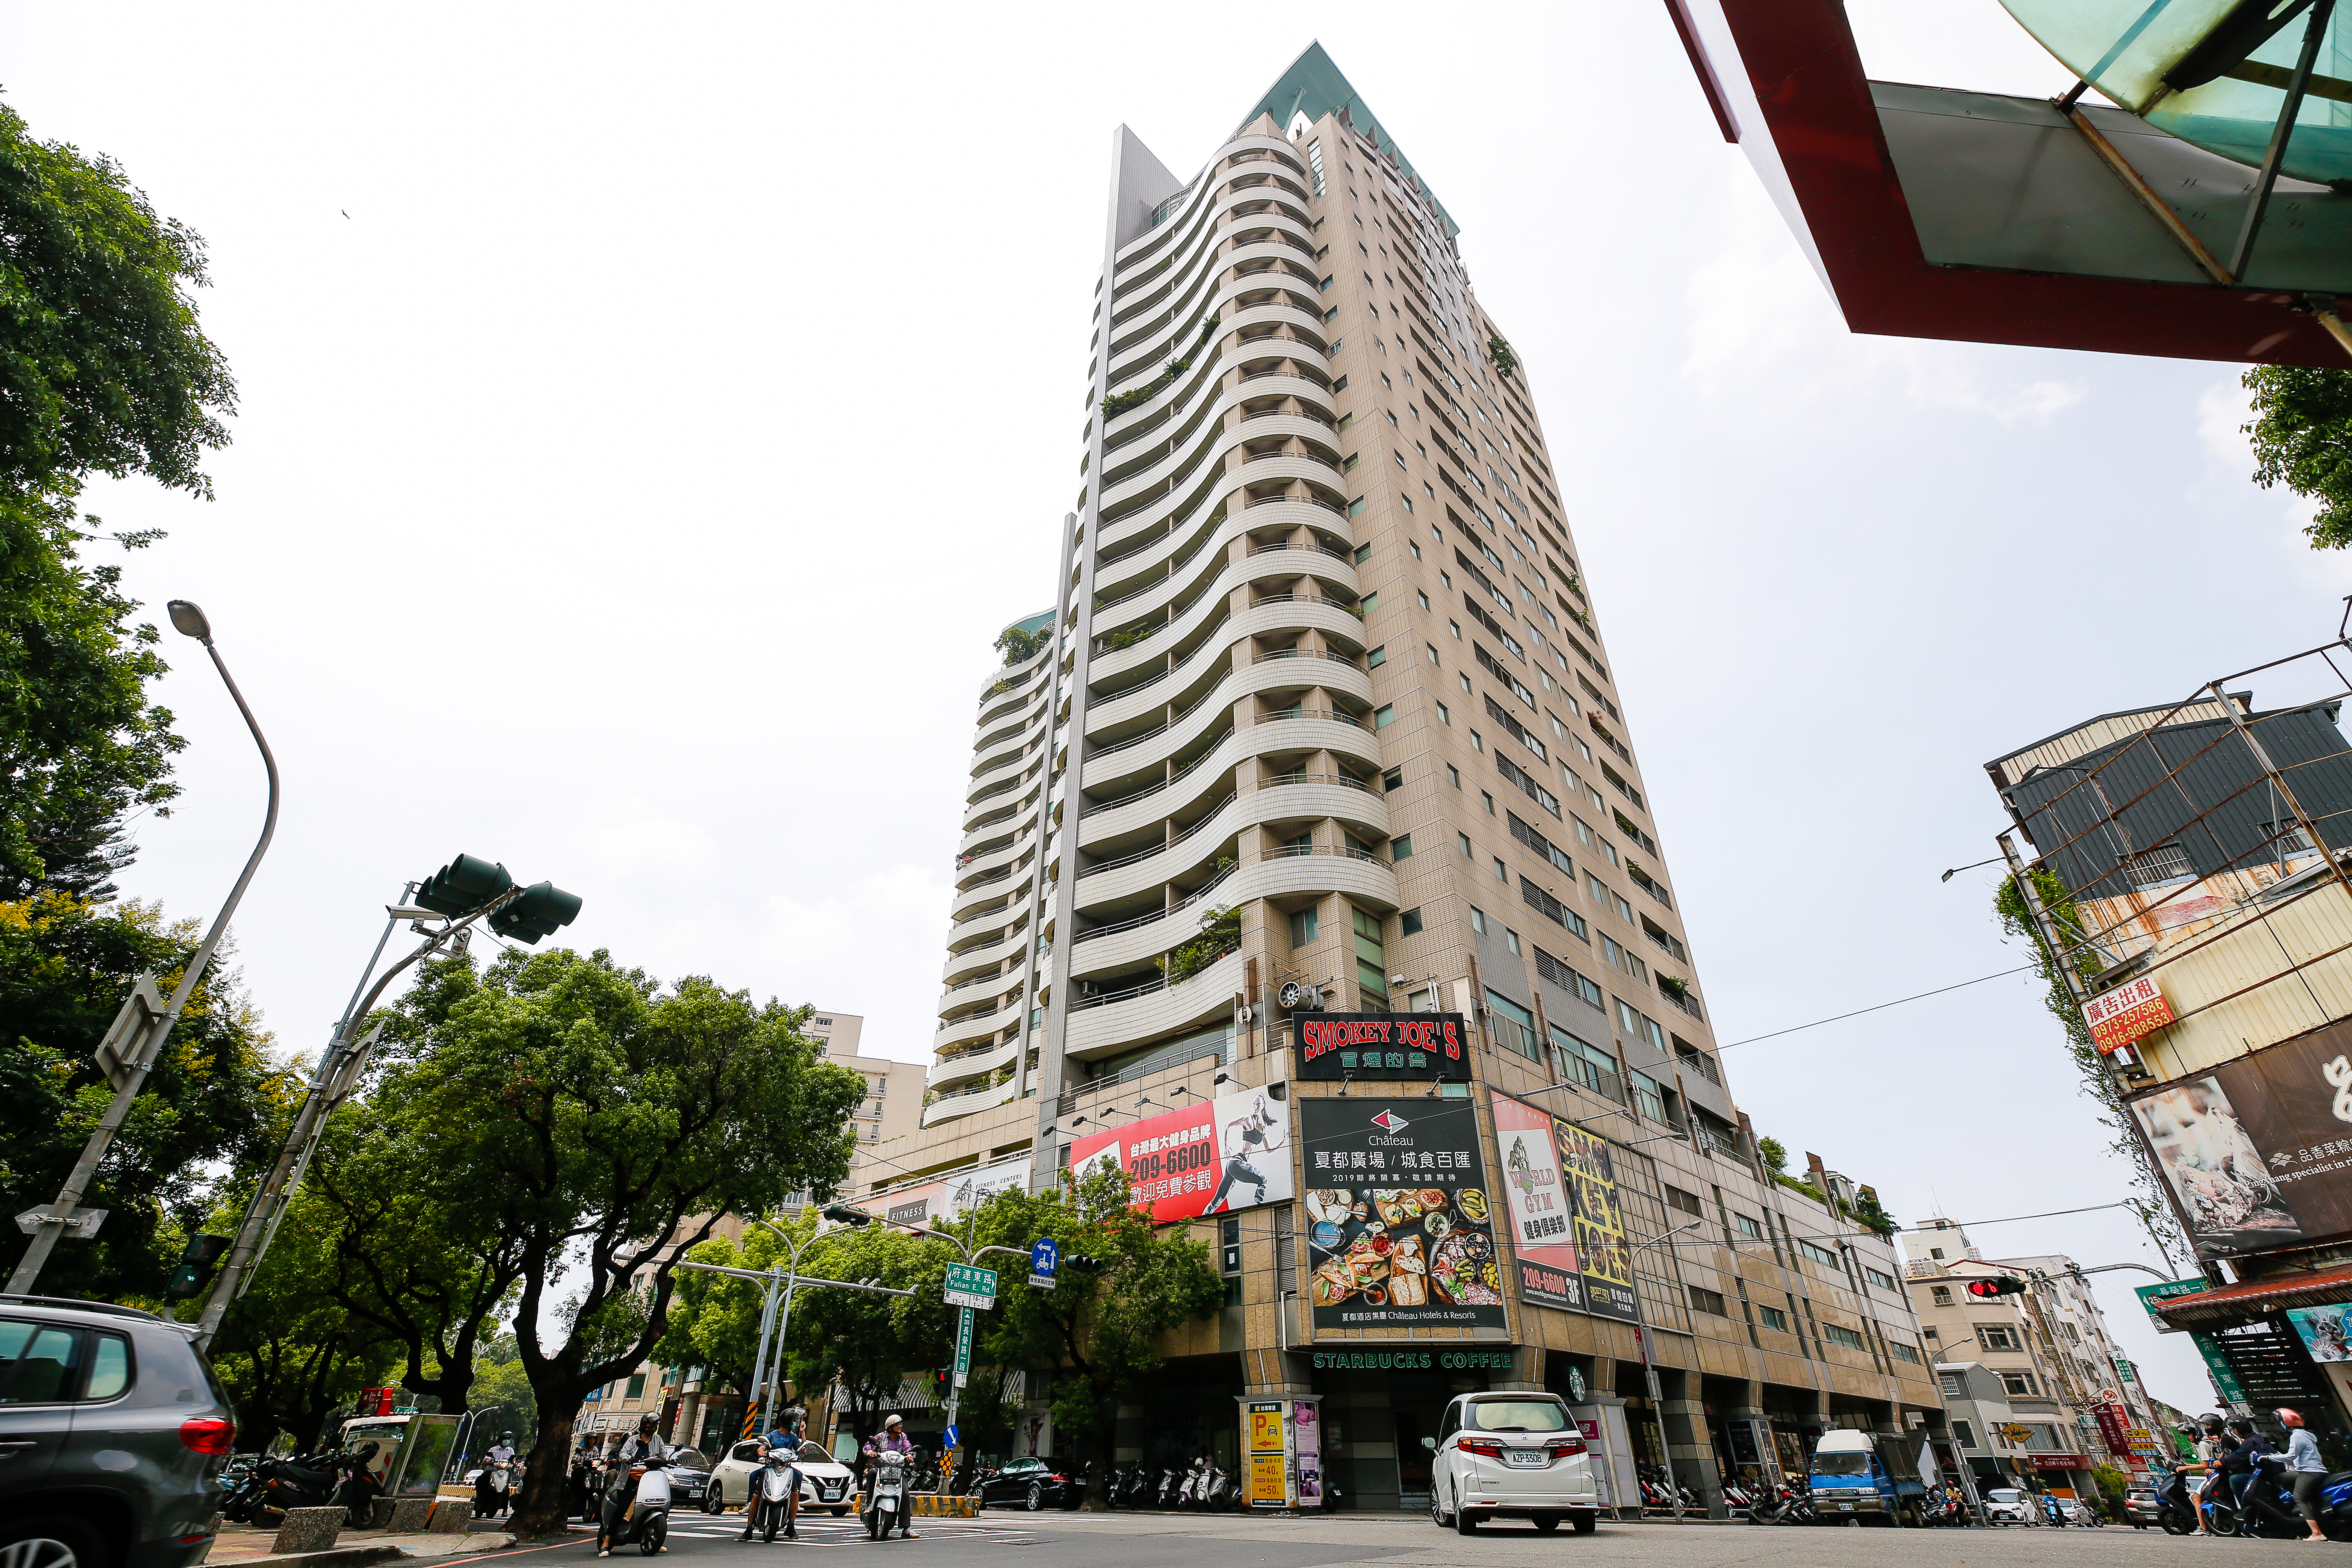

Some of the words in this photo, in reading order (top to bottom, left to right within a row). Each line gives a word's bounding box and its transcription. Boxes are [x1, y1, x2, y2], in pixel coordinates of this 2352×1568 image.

[2086, 978, 2156, 1024] 廣告出租
[2093, 998, 2164, 1039] 0973-257586
[1304, 1020, 1391, 1062] SMOKEY
[1398, 1021, 1460, 1060] JOE'S
[2099, 1011, 2170, 1052] 0916-908553
[1340, 1052, 1427, 1068] 冒煙的喬
[1130, 1123, 1211, 1158] 台灣最大健身品牌
[1368, 1135, 1414, 1146] Château
[1130, 1142, 1211, 1184] 209-6600
[1314, 1151, 1386, 1169] 夏都廣場
[1401, 1151, 1471, 1169] 城食百匯
[2292, 1163, 2334, 1180] specialist
[2333, 1160, 2346, 1169] in
[976, 1181, 996, 1190] FITNESS
[1000, 1174, 1022, 1184] CENTERS
[1129, 1169, 1212, 1206] 歡迎免費參觀
[892, 1205, 923, 1221] FITNESS
[1525, 1193, 1553, 1214] GYM
[1523, 1214, 1567, 1240] 健身俱樂部
[951, 1267, 992, 1285] 府連東路
[950, 1280, 969, 1289] Fulian
[982, 1285, 991, 1293] Rd.
[1523, 1267, 1566, 1295] 209-6600
[1566, 1277, 1580, 1305] 3F
[1525, 1288, 1567, 1302] www.worldgymtaiwan.com
[1610, 1288, 1634, 1305] 冒煙的喬
[1342, 1311, 1386, 1321] 夏都酒店集團
[1388, 1311, 1418, 1320] Château
[1450, 1311, 1476, 1319] Resorts
[2151, 1315, 2163, 1325] 南
[959, 1326, 969, 1371] 長榮路一段
[1313, 1353, 1431, 1368] STARBUCKS
[1441, 1353, 1511, 1367] COFFEE
[2203, 1342, 2243, 1400] 府連東路
[1255, 1415, 1267, 1437] P
[1266, 1465, 1276, 1475] 40
[1267, 1485, 1276, 1495] 50
